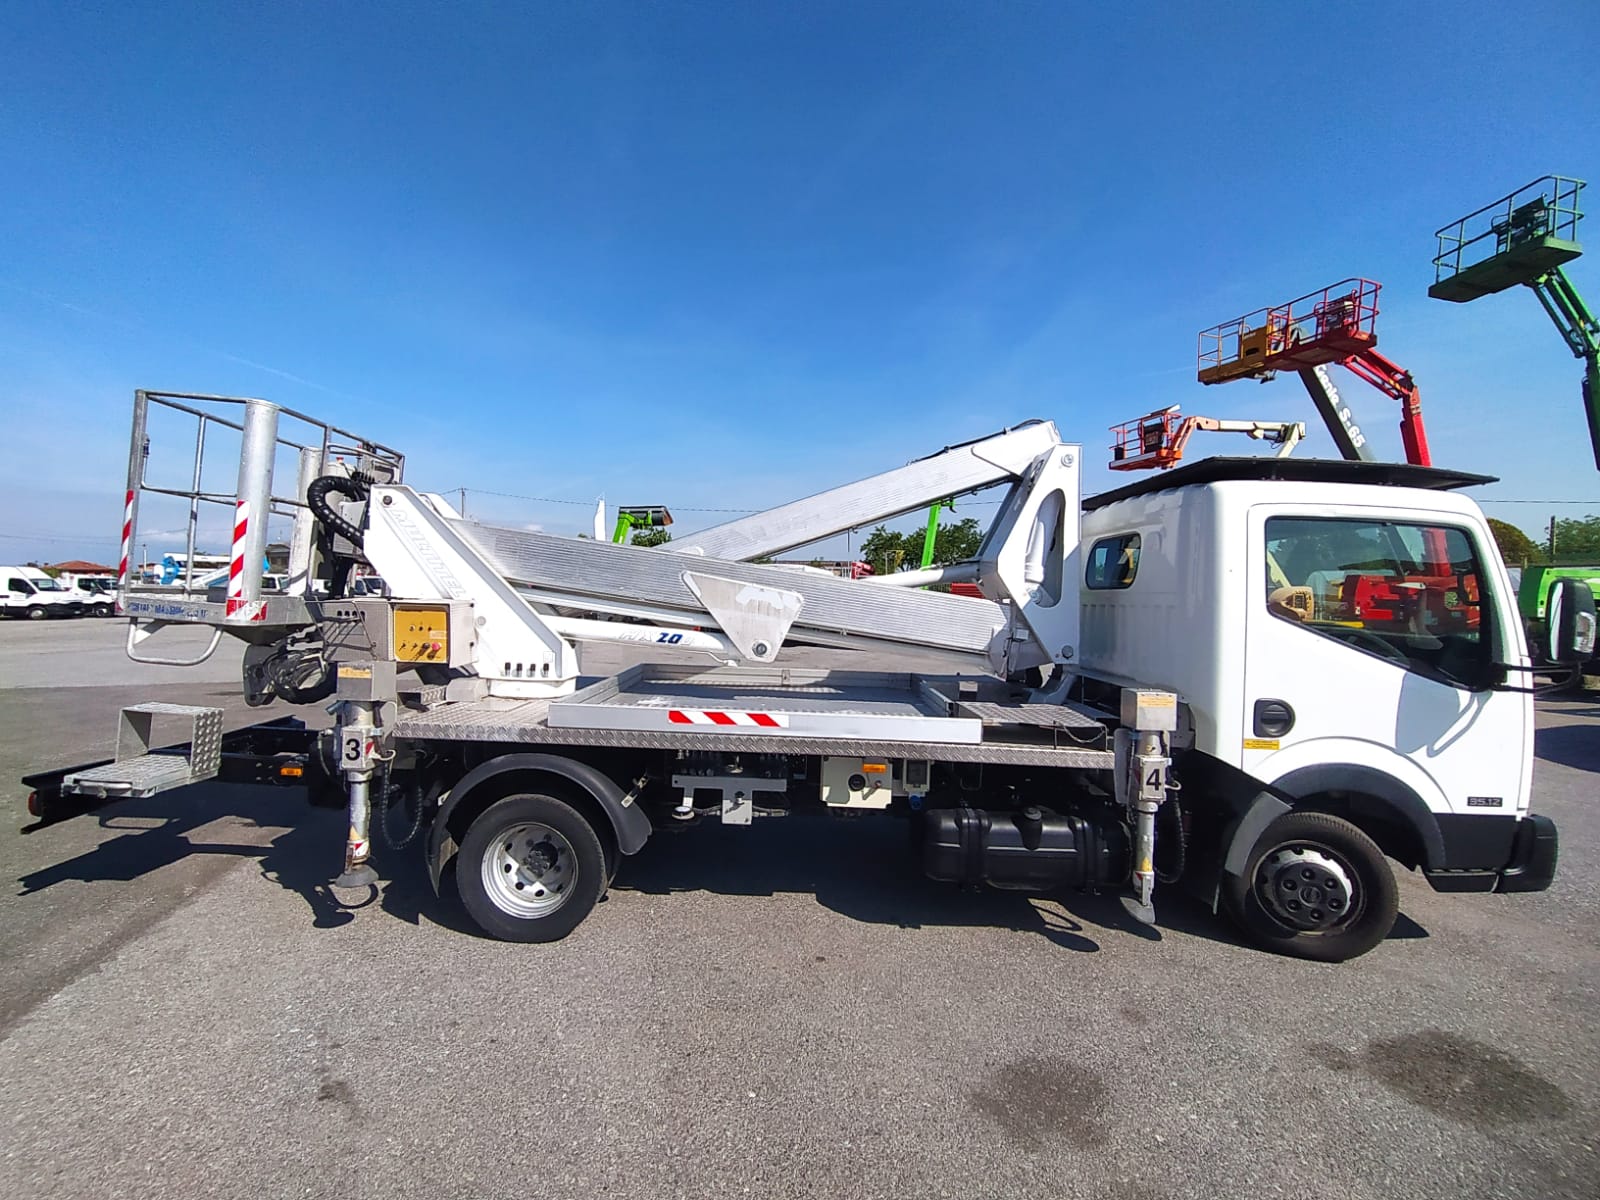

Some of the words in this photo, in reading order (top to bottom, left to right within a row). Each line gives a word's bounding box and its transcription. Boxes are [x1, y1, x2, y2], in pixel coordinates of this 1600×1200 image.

[1339, 407, 1366, 448] S-65
[345, 738, 361, 761] 3
[1145, 768, 1162, 792] 4
